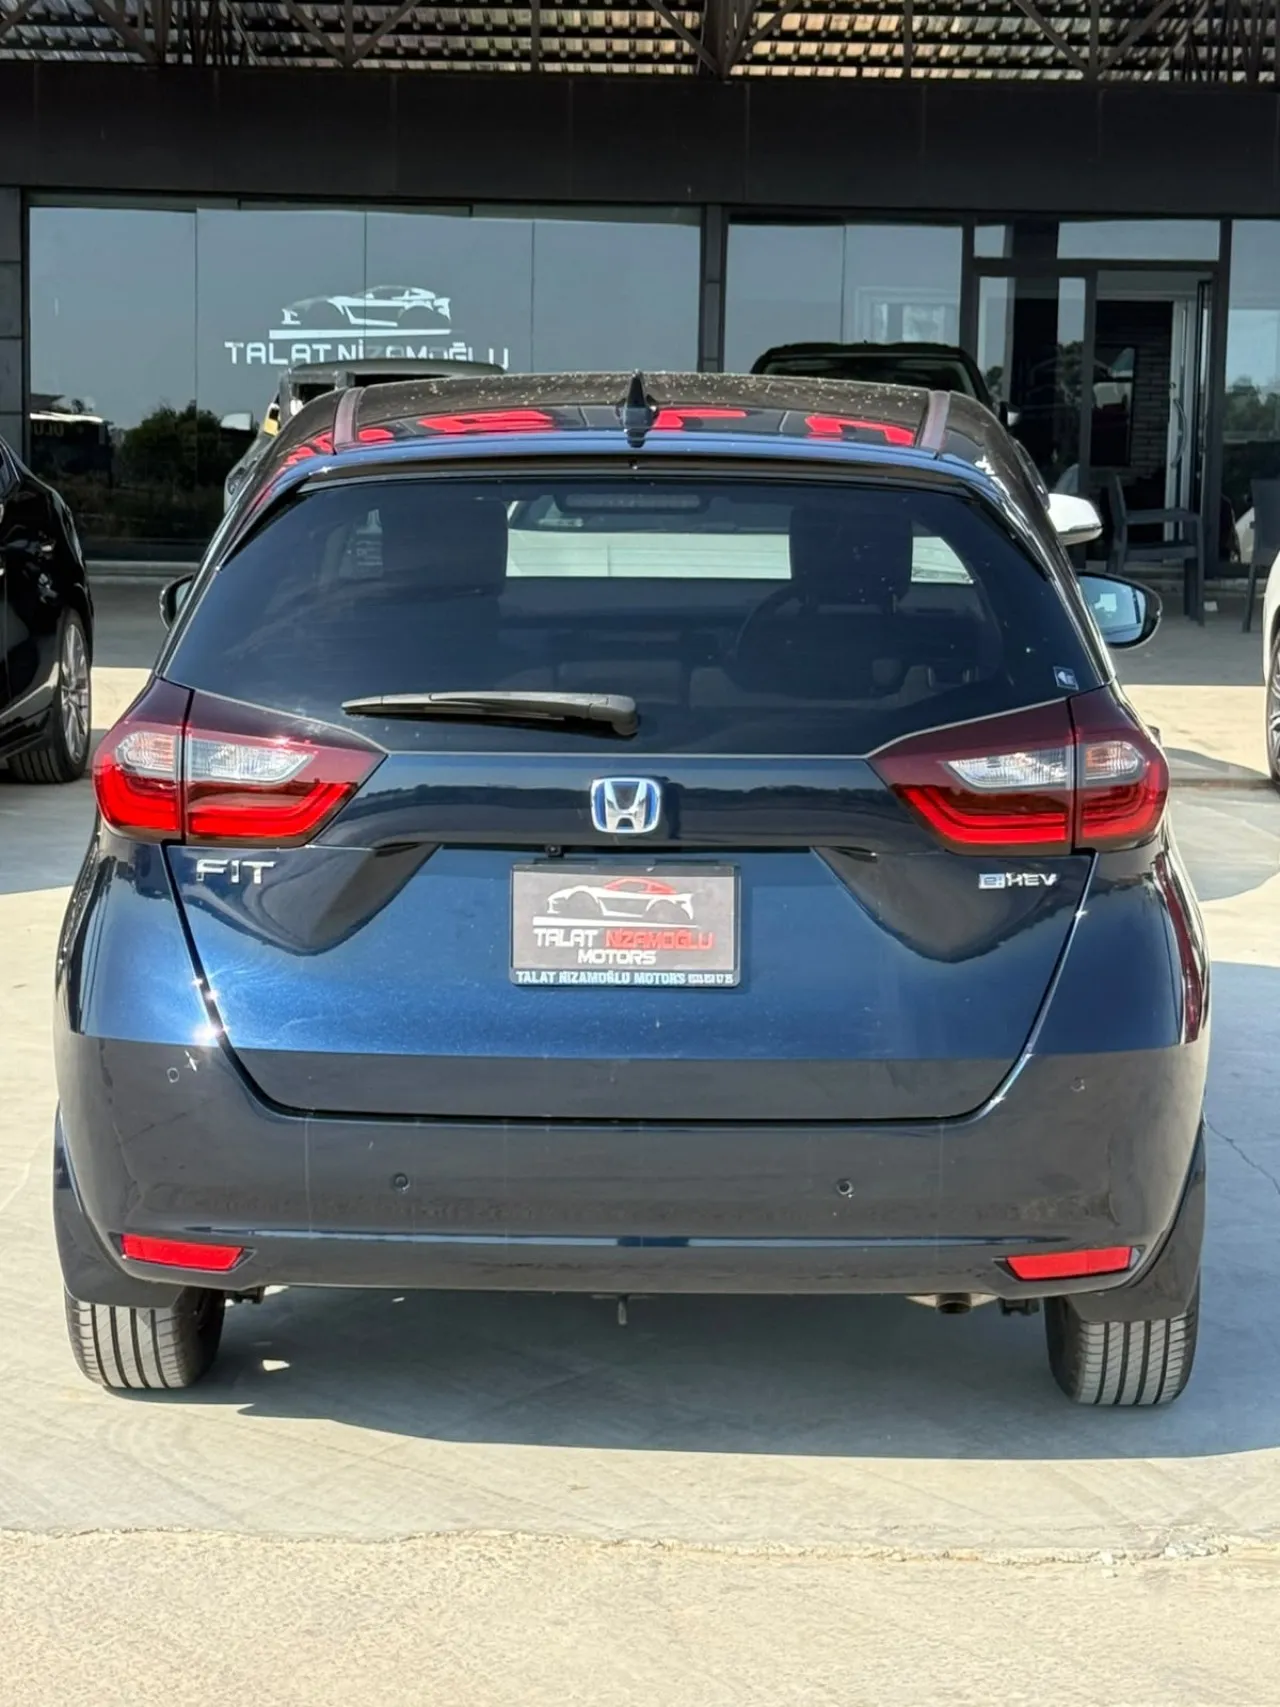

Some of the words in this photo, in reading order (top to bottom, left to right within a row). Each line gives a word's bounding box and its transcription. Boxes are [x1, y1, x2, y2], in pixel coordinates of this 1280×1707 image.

[224, 341, 332, 365] TALAT
[196, 859, 276, 884] FIT
[533, 928, 599, 947] TALAT
[577, 949, 657, 965] MOTORS
[515, 970, 556, 983] TALAT
[634, 971, 686, 985] MOTORS
